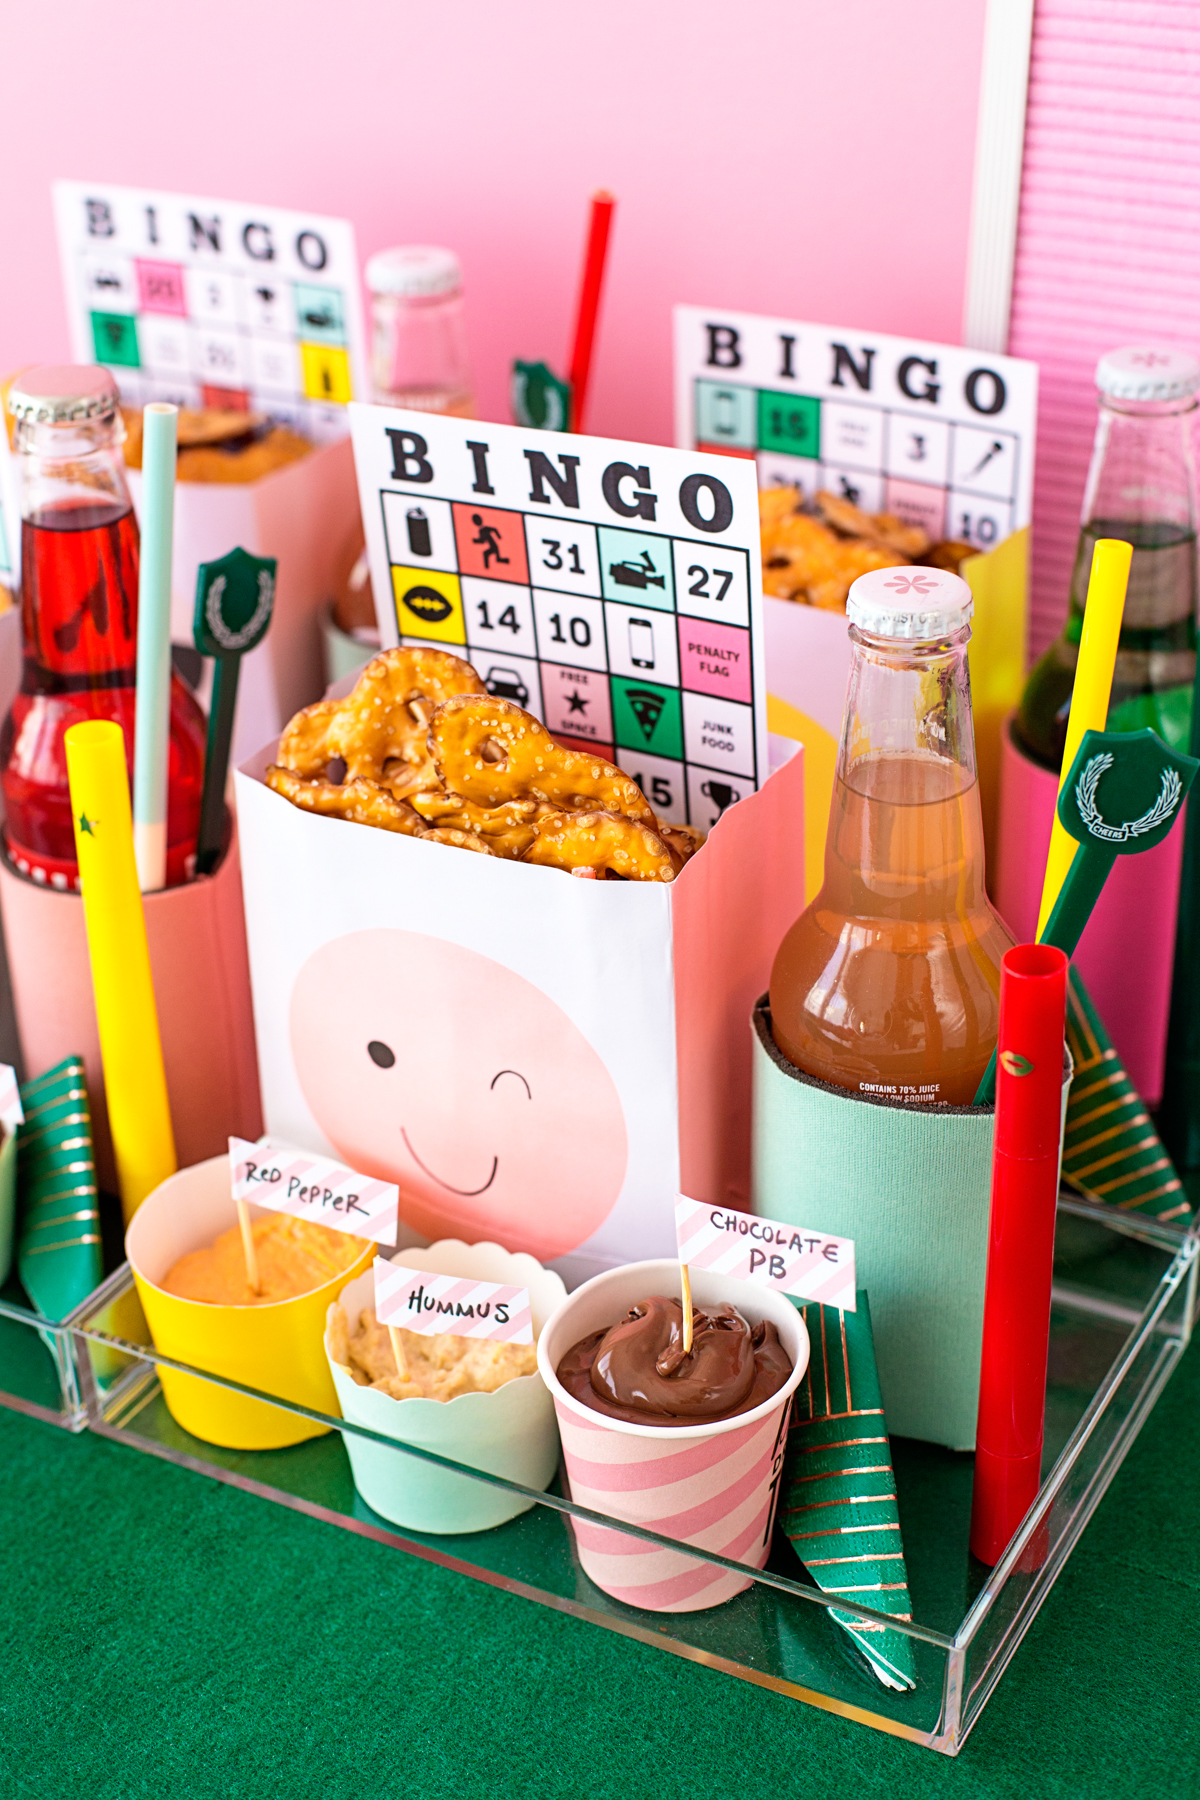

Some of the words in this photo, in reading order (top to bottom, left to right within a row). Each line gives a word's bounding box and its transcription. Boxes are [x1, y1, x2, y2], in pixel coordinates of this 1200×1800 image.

[84, 197, 328, 270] BINGO
[704, 323, 1006, 415] BINGO
[385, 428, 734, 534] BINGO
[541, 538, 585, 575] 31
[687, 564, 733, 602] 27
[477, 600, 521, 635] 14
[549, 613, 591, 647] 10
[687, 642, 740, 663] PENALTY
[700, 661, 730, 678] FLAG
[701, 720, 734, 736] JUNK
[701, 735, 735, 753] FOOD
[1092, 825, 1124, 839] CHEERS
[859, 1082, 897, 1094] CONTAINS
[899, 1086, 917, 1094] 70%
[918, 1083, 941, 1094] JUICE
[710, 1210, 839, 1263] CHOCOLATE
[749, 1248, 787, 1280] PB
[407, 1284, 510, 1325] HUMMUS
